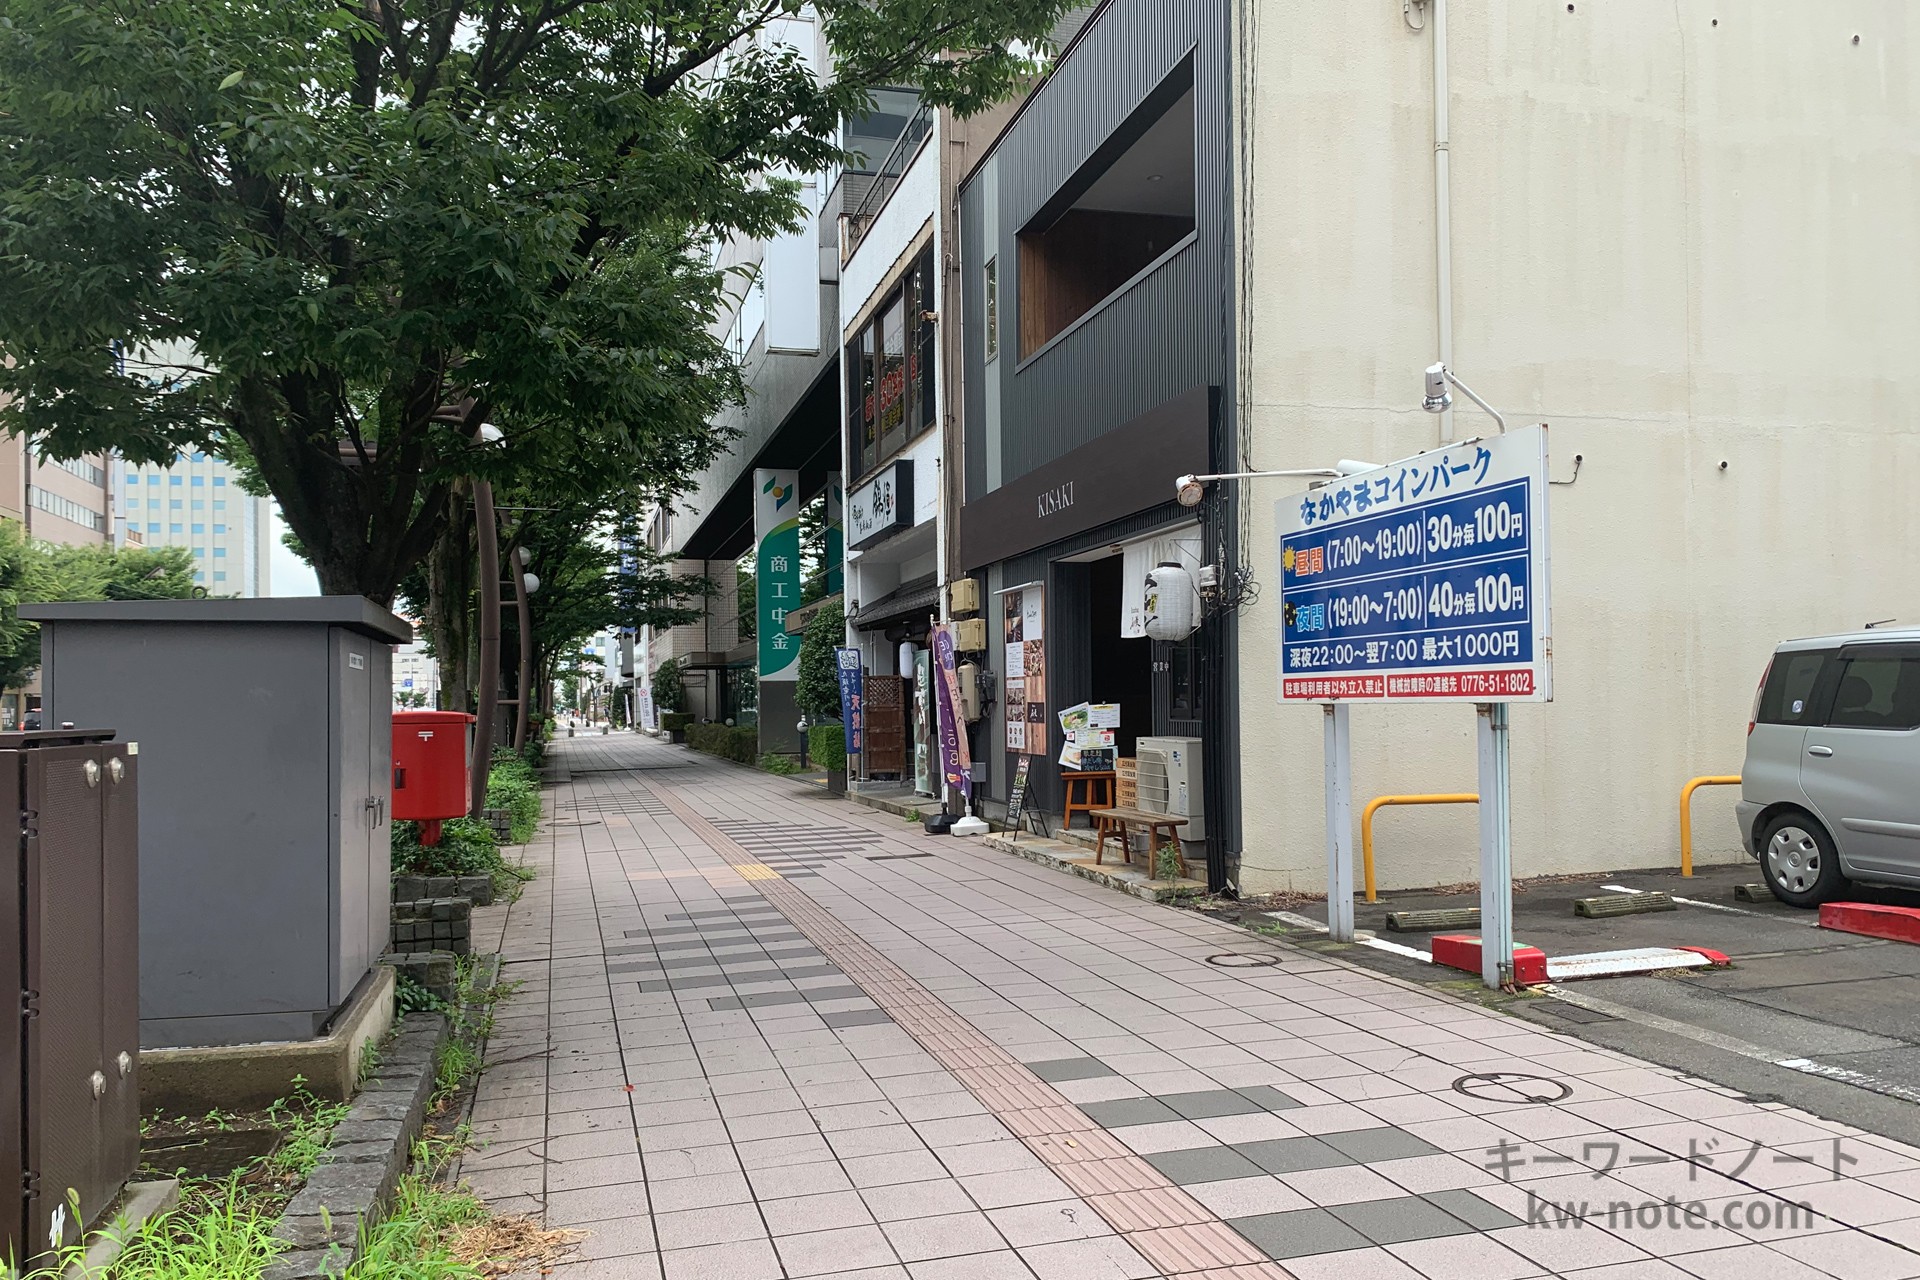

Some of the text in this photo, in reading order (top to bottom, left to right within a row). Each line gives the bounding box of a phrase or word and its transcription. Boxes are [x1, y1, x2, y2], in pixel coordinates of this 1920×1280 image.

[1038, 481, 1073, 518] KISAKI
[1300, 446, 1491, 525] なかやまコインパーク
[1295, 547, 1324, 576] 昼間
[1427, 501, 1522, 553] 30分毎100円
[770, 555, 789, 650] 商工中金
[1296, 604, 1325, 632] 夜間
[1428, 572, 1523, 618] 40分毎100円
[1422, 630, 1519, 661] 最大1000円
[1285, 679, 1383, 695] 駐車場利用者以外立入禁止
[1389, 673, 1530, 694] 機械故障時の連絡先 0776-51-1802
